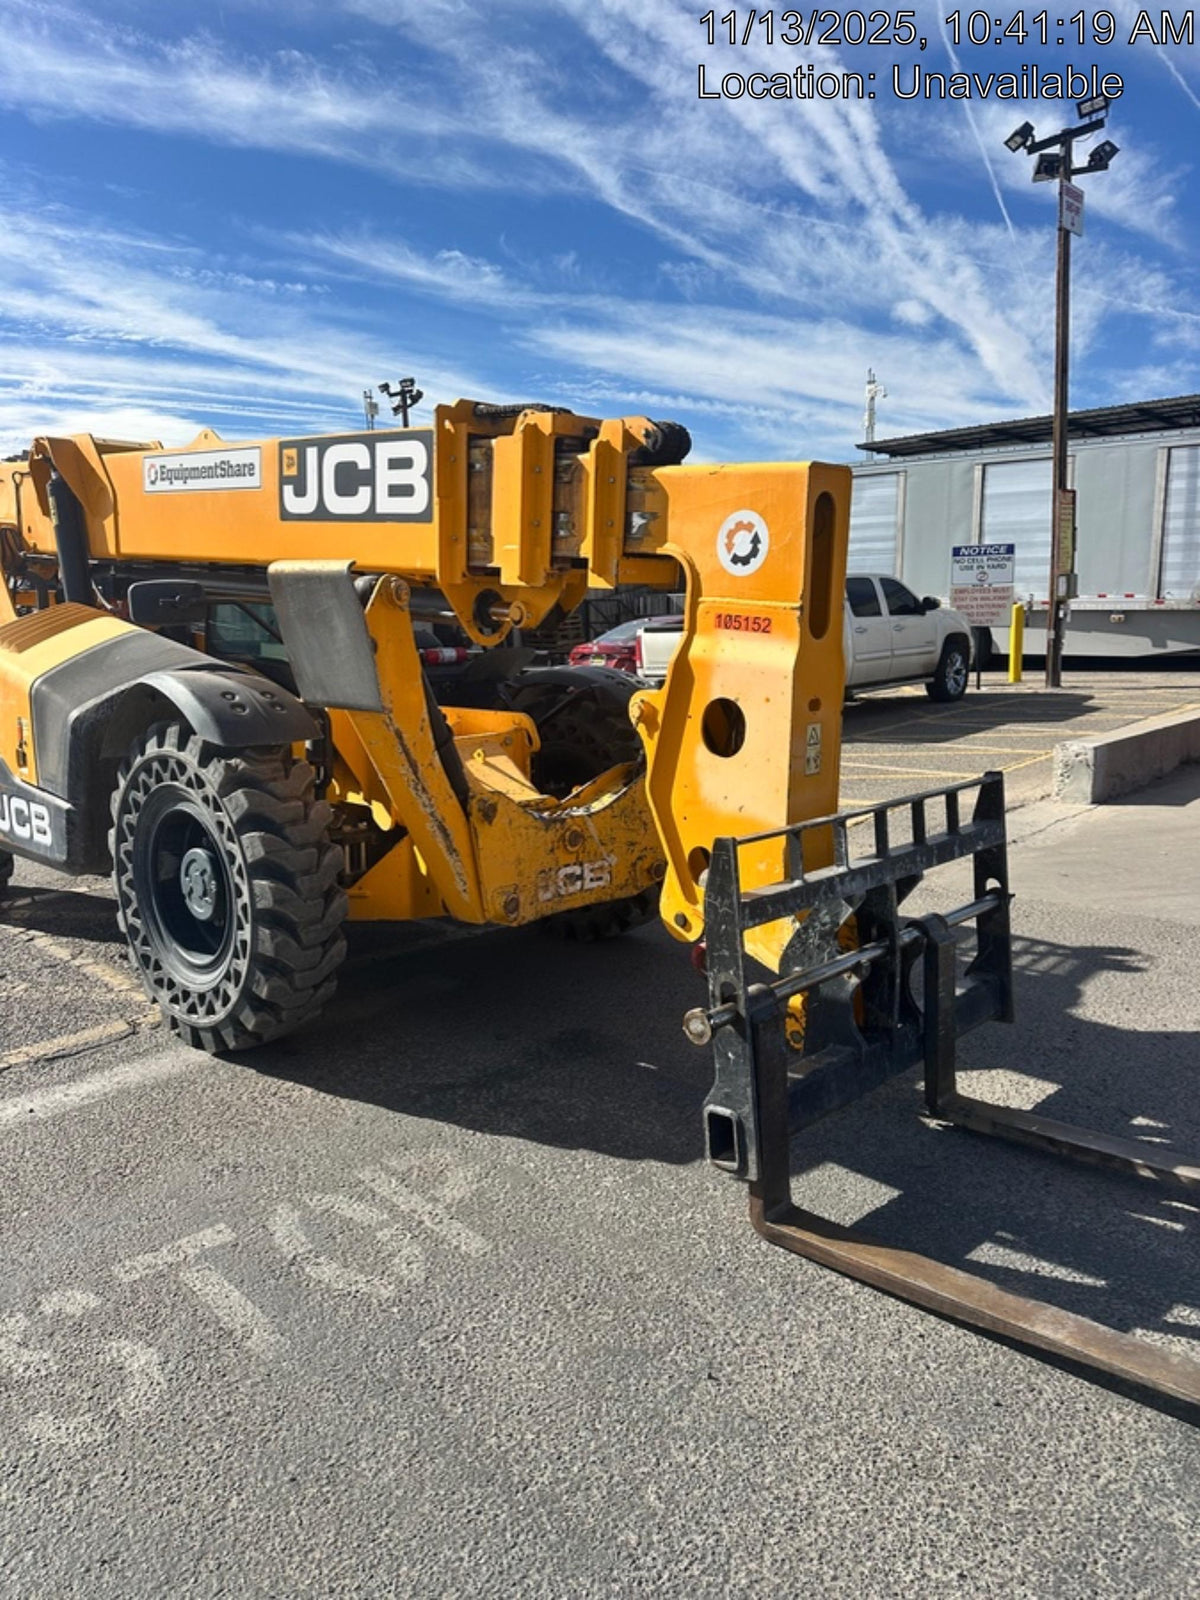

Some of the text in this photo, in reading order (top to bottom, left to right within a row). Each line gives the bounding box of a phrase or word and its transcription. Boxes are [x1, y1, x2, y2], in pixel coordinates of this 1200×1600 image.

[159, 459, 255, 484] EquipmentShare
[282, 440, 430, 515] JCB
[960, 545, 1008, 556] NOTICE
[715, 613, 772, 633] 105152
[0, 794, 52, 847] JCB
